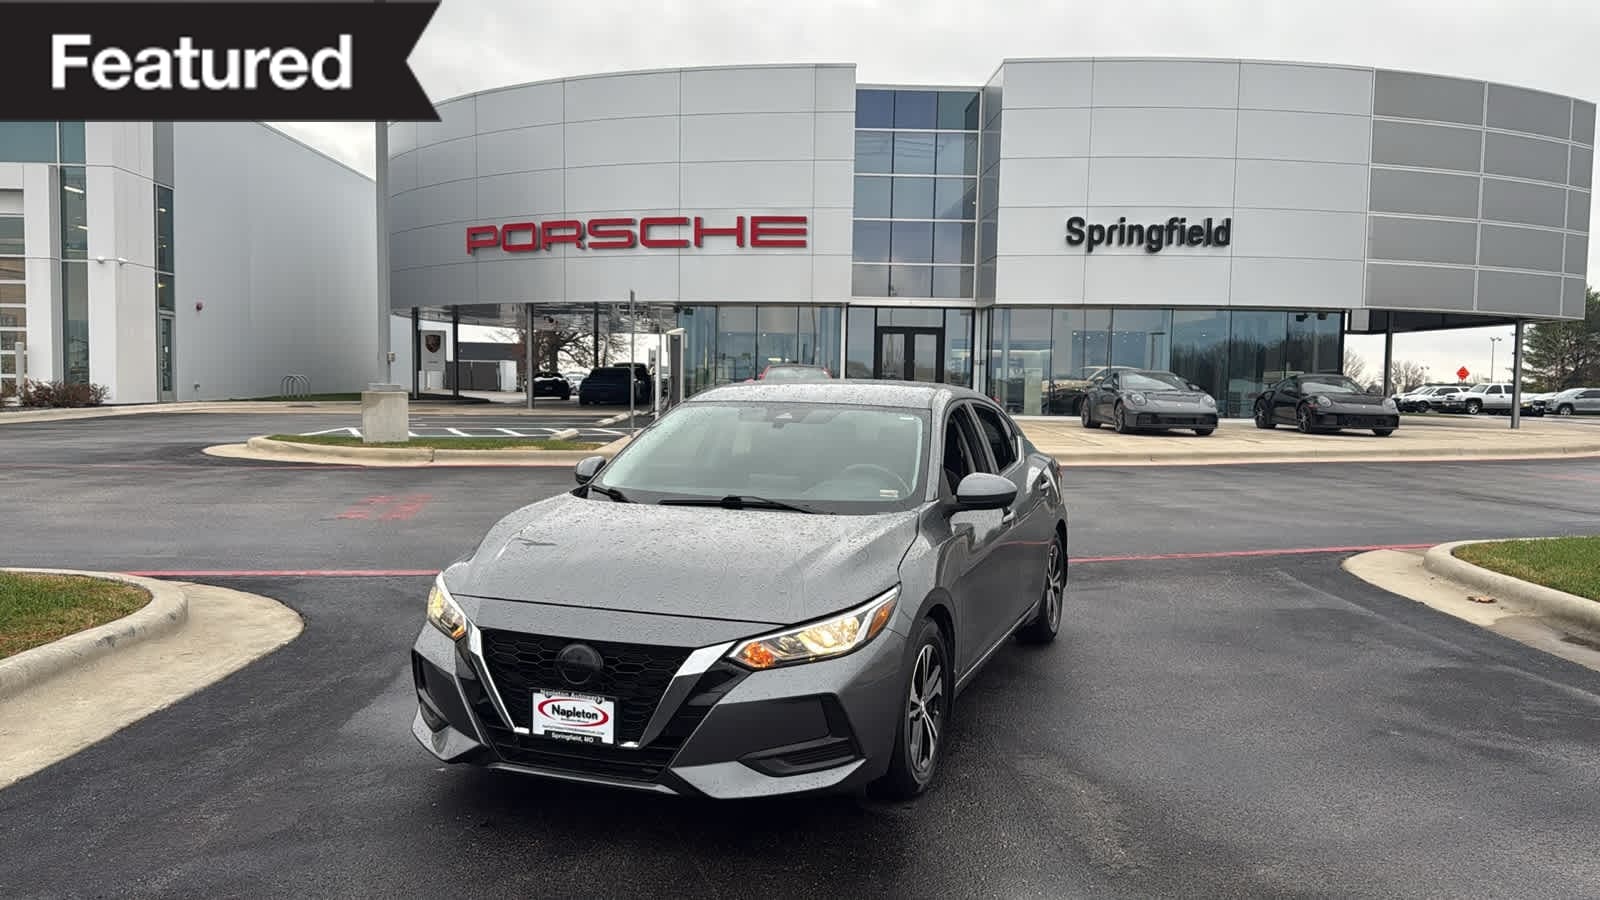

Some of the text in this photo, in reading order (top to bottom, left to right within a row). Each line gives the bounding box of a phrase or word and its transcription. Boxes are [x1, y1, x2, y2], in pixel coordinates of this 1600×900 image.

[466, 216, 808, 255] PORSCHE
[1065, 216, 1232, 254] Springfield
[551, 704, 599, 720] Napleton
